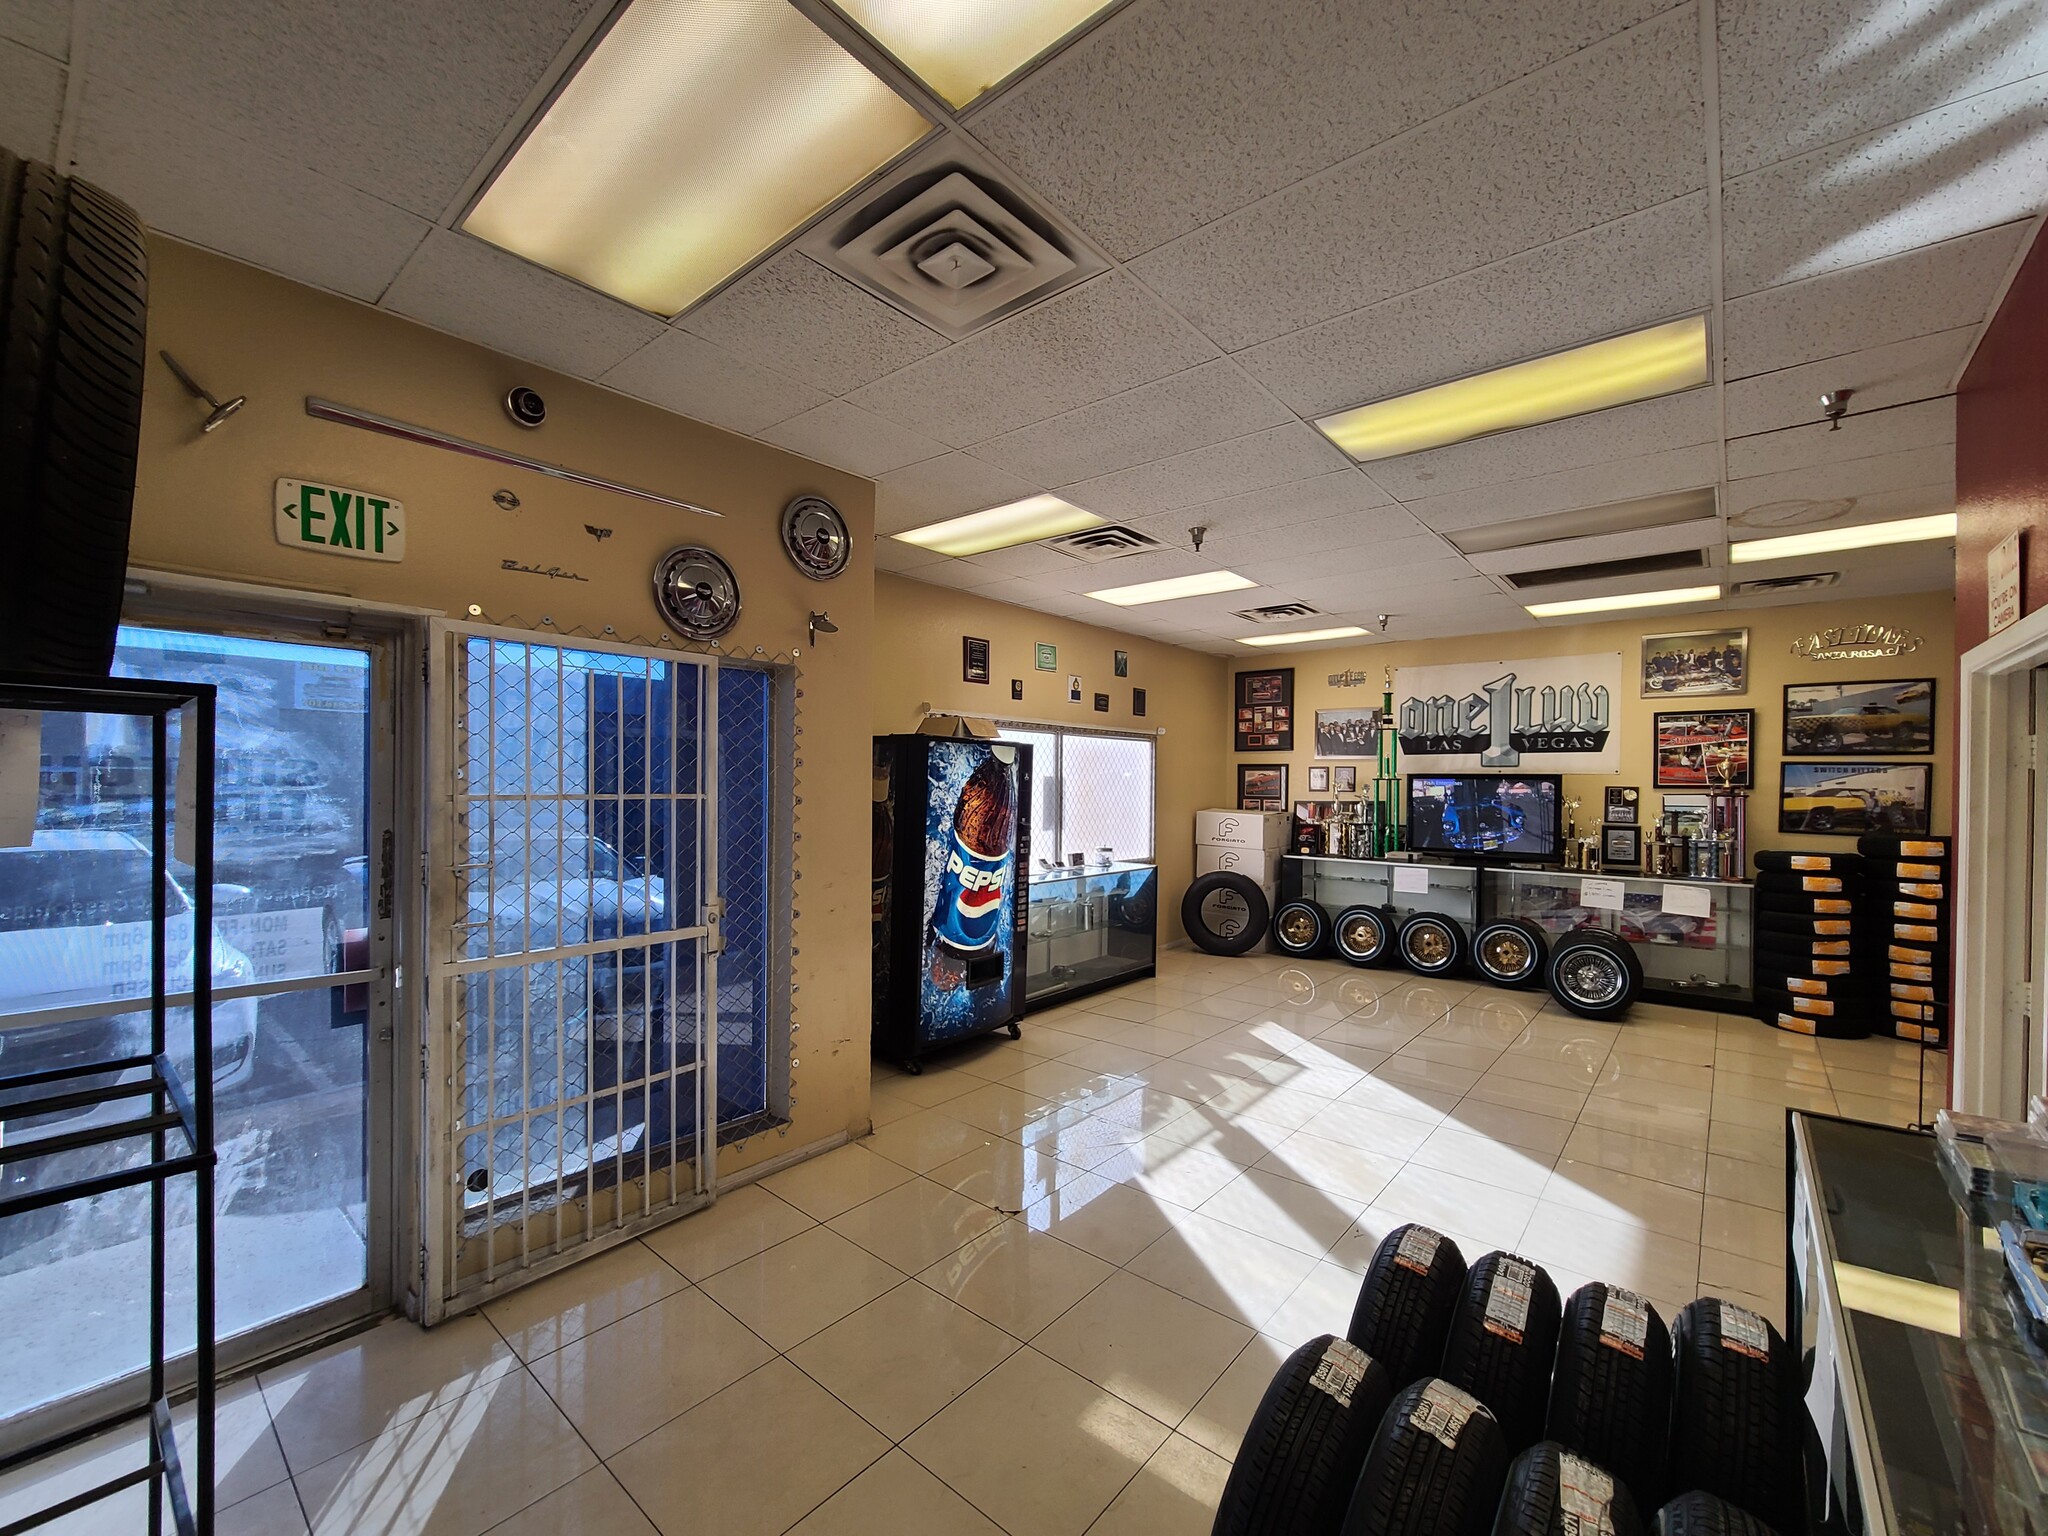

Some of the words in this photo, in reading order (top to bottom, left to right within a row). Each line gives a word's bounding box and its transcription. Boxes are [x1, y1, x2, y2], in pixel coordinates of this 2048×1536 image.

[300, 484, 390, 554] EXIT
[1812, 650, 1849, 661] SANTA
[1851, 648, 1884, 660] ROSA
[1426, 738, 1462, 751] LAS
[1521, 735, 1595, 751] VEGAS
[1211, 836, 1246, 844] FORGIATO
[946, 849, 1007, 893] PEPSI
[1212, 903, 1247, 912] FORGIATO
[1314, 1358, 1332, 1381] 35871
